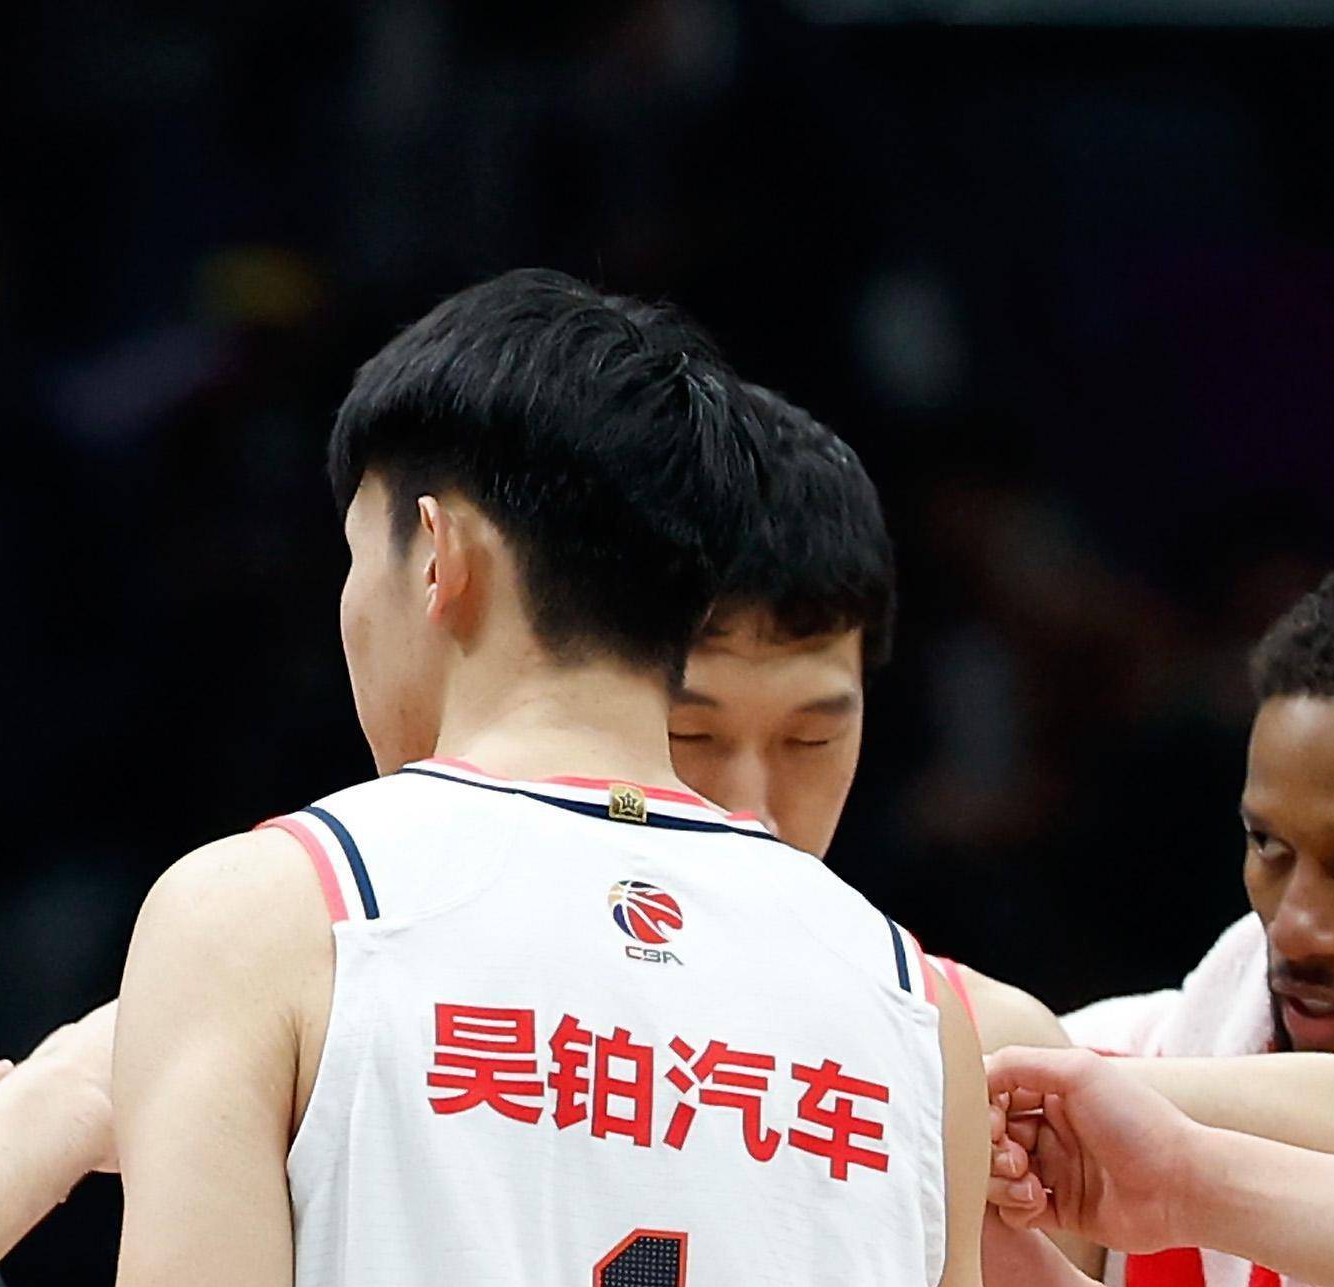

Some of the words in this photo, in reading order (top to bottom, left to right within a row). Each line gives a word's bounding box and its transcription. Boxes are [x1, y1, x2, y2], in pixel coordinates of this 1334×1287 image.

[625, 946, 684, 966] CBA
[426, 1001, 890, 1182] 昊铂汽车
